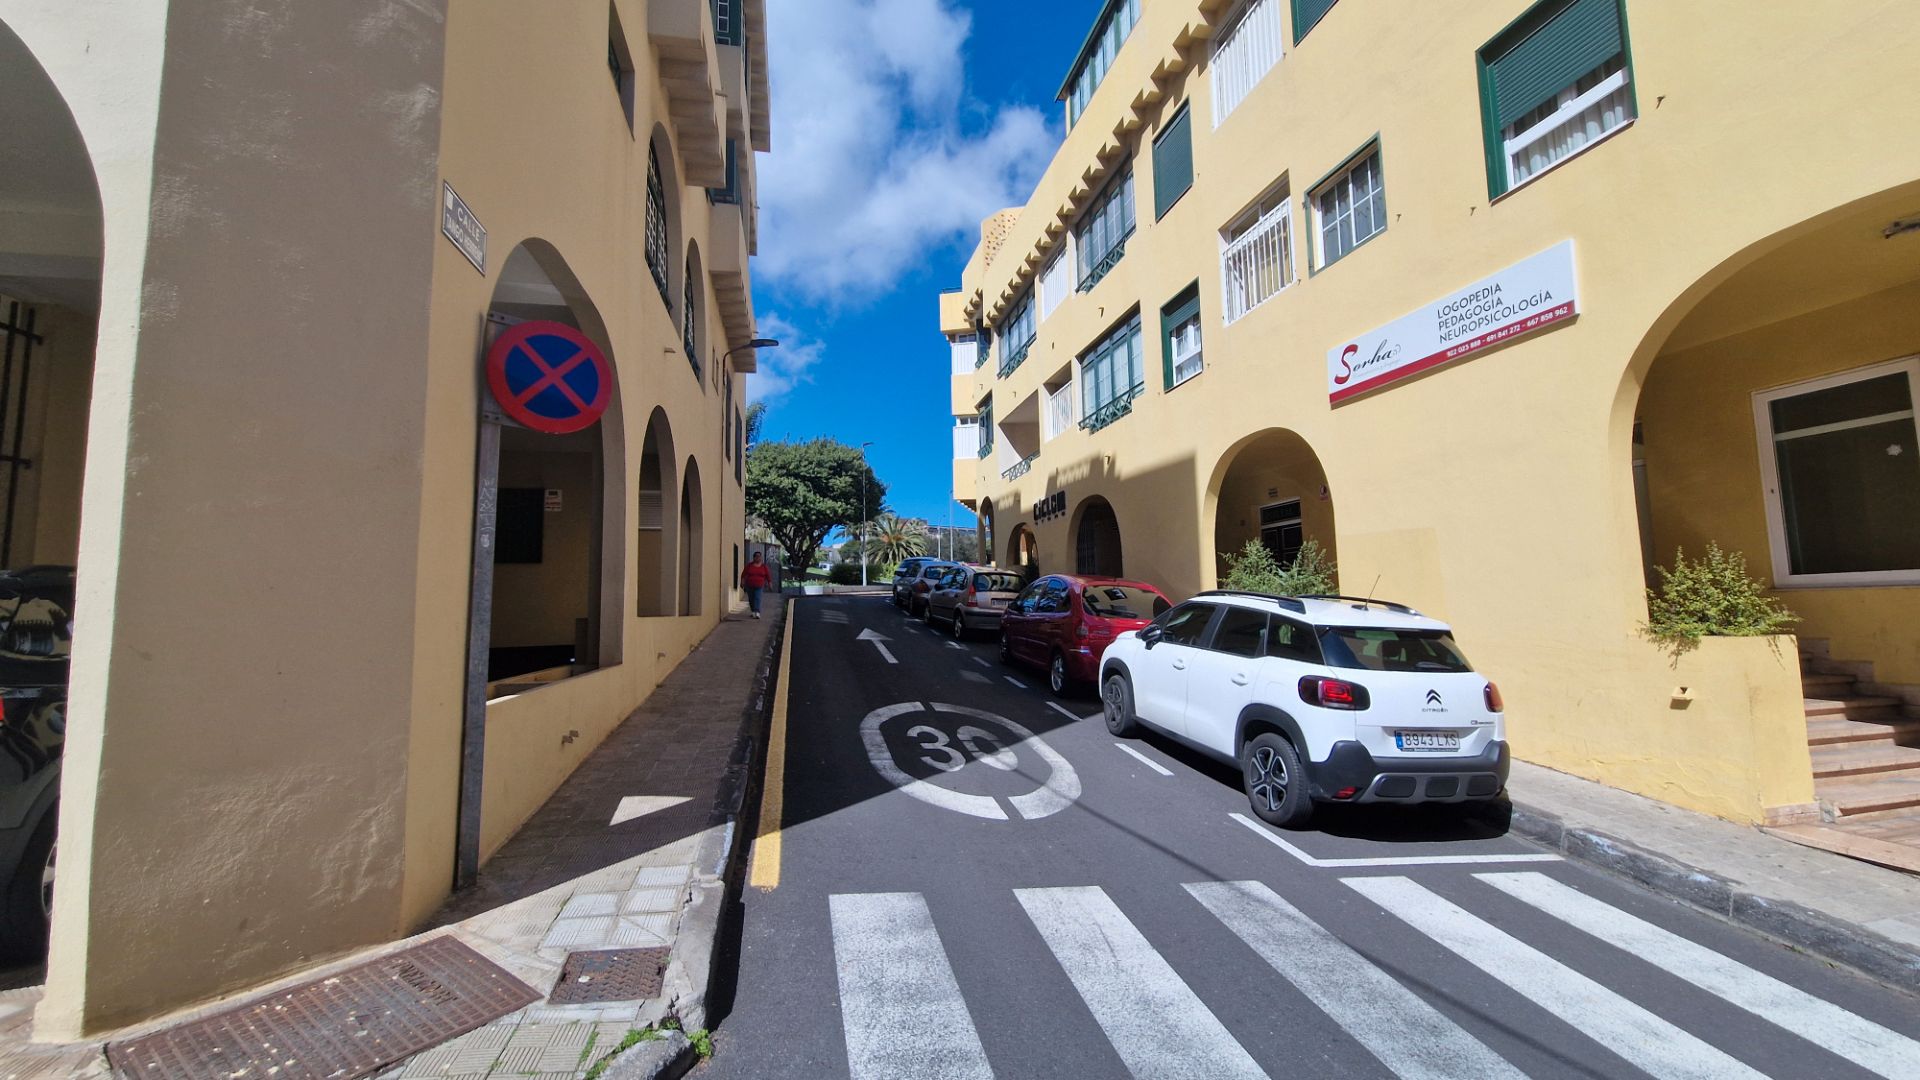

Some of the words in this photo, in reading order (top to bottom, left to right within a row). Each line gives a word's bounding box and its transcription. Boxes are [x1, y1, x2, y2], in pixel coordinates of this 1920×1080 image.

[458, 207, 480, 242] CALLE
[1437, 282, 1502, 319] LOGOPEDIA
[1438, 295, 1504, 331] PEDAGOGÍA
[1439, 290, 1553, 344] NEUROPSICOLOGÍA
[1554, 306, 1568, 317] 962
[1334, 338, 1393, 385] Sorha
[906, 725, 1019, 773] 30
[1405, 733, 1434, 746] 8943
[1436, 733, 1457, 746] LXS
